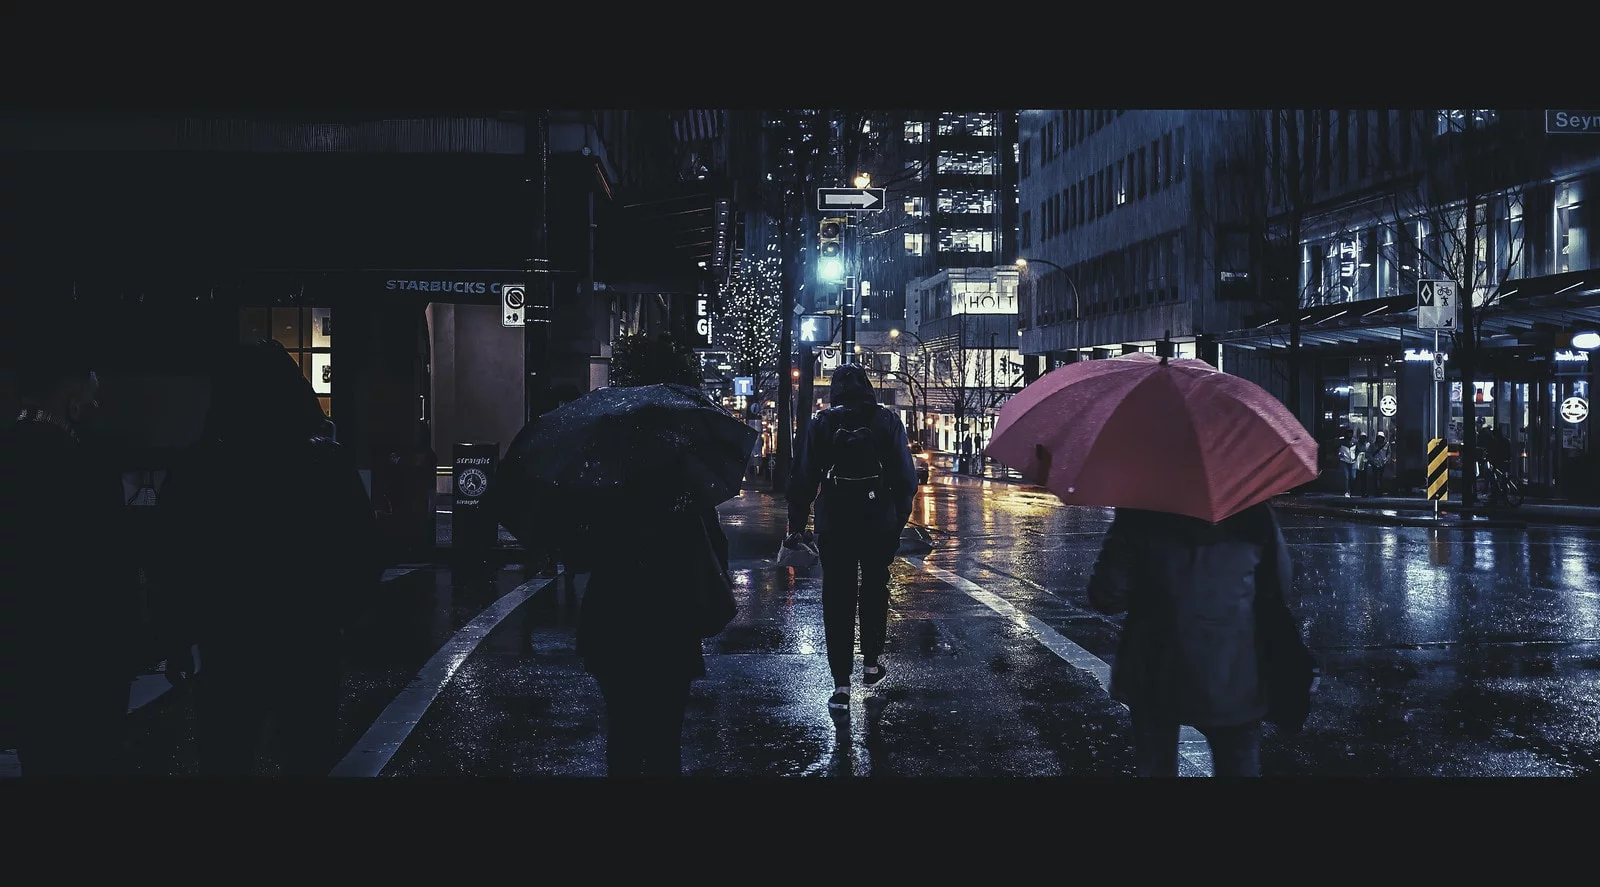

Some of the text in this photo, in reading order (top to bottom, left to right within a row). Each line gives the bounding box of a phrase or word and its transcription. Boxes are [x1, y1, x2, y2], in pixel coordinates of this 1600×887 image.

[385, 280, 486, 295] STARBUCKS
[969, 295, 1014, 309] HOLT
[697, 294, 708, 336] EG
[738, 379, 750, 394] T
[456, 457, 490, 465] straight
